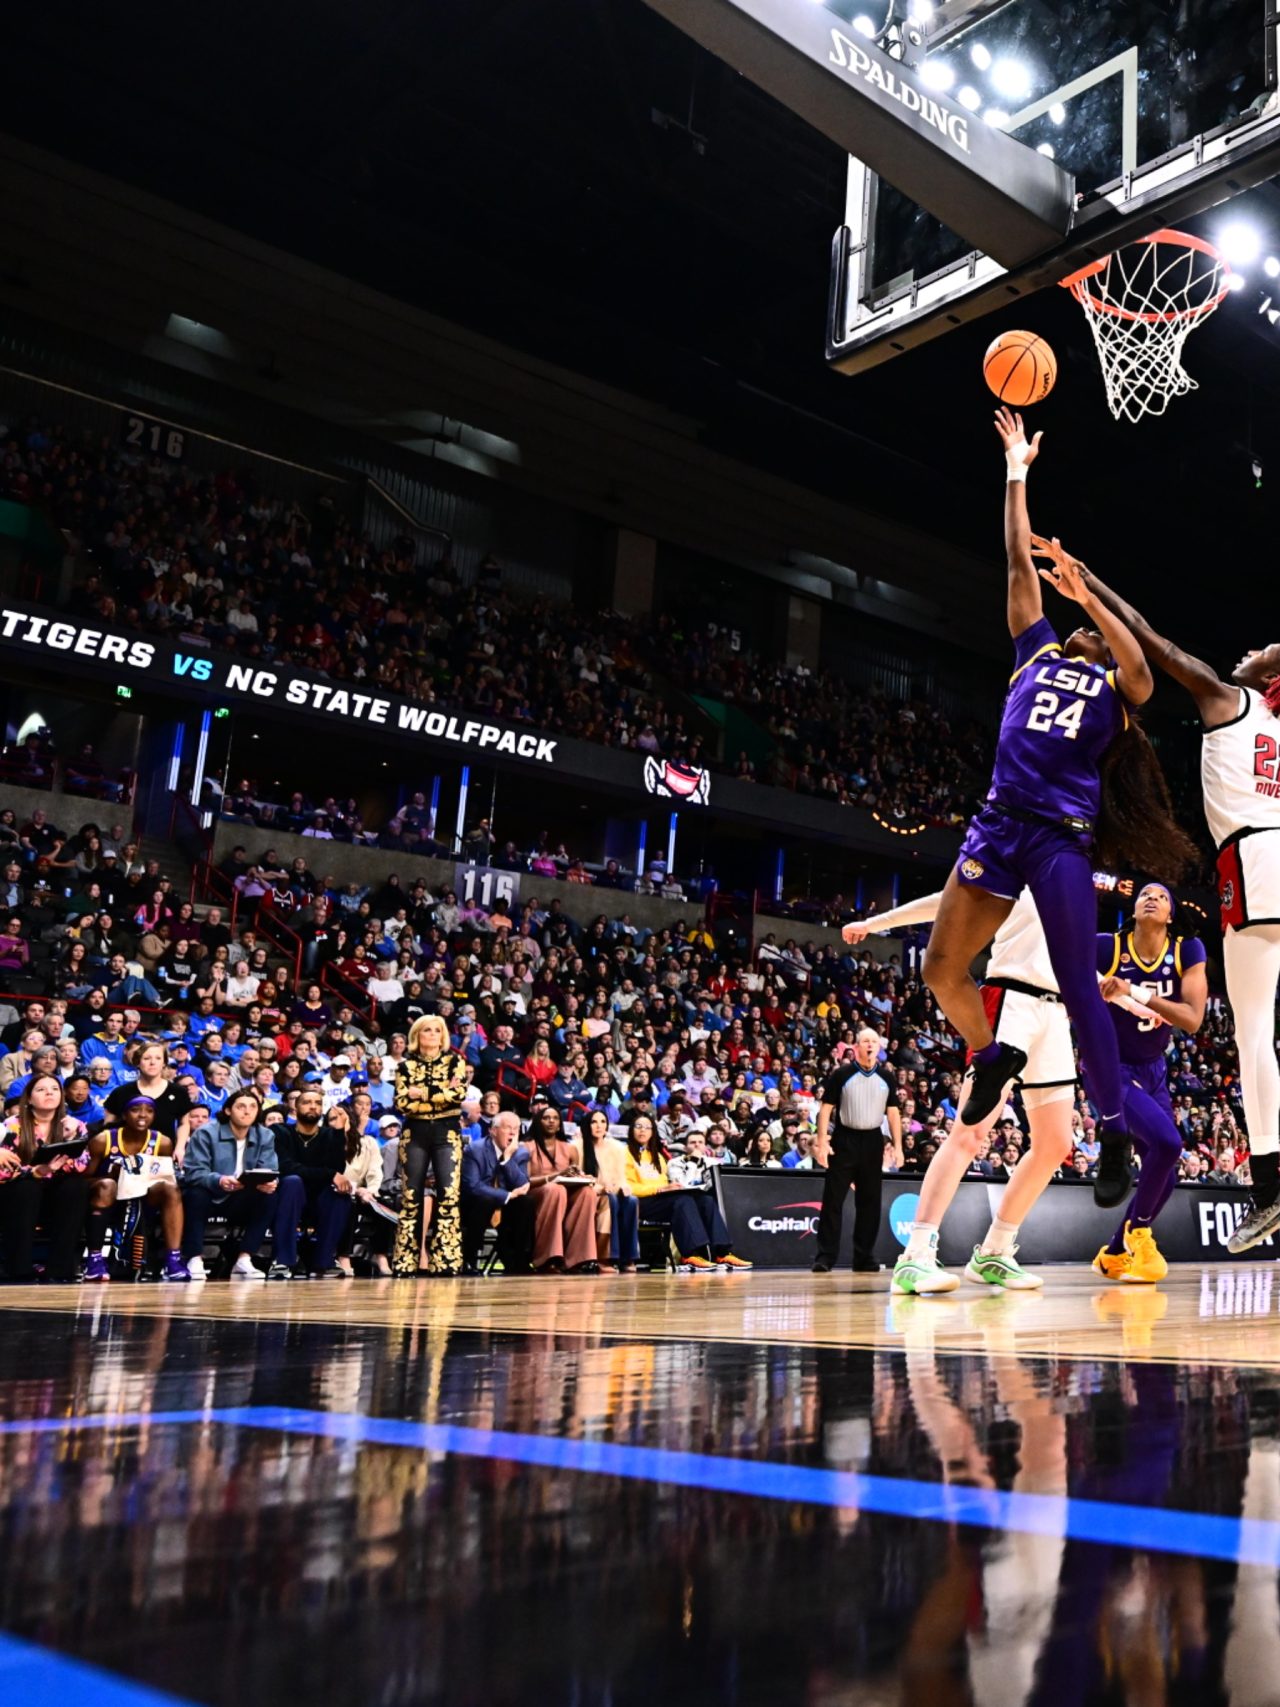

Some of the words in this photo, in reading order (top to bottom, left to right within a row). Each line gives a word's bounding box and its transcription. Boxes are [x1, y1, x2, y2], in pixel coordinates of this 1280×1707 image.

[829, 28, 971, 155] SPALDING
[126, 417, 184, 458] 216
[1, 609, 156, 668] TIGERS
[173, 654, 213, 681] VS
[225, 664, 278, 697] NC
[285, 679, 391, 724] STATE
[397, 704, 558, 763] WOLFPACK
[1034, 666, 1104, 697] LSU
[1026, 691, 1086, 740] 24
[464, 870, 513, 908] 116
